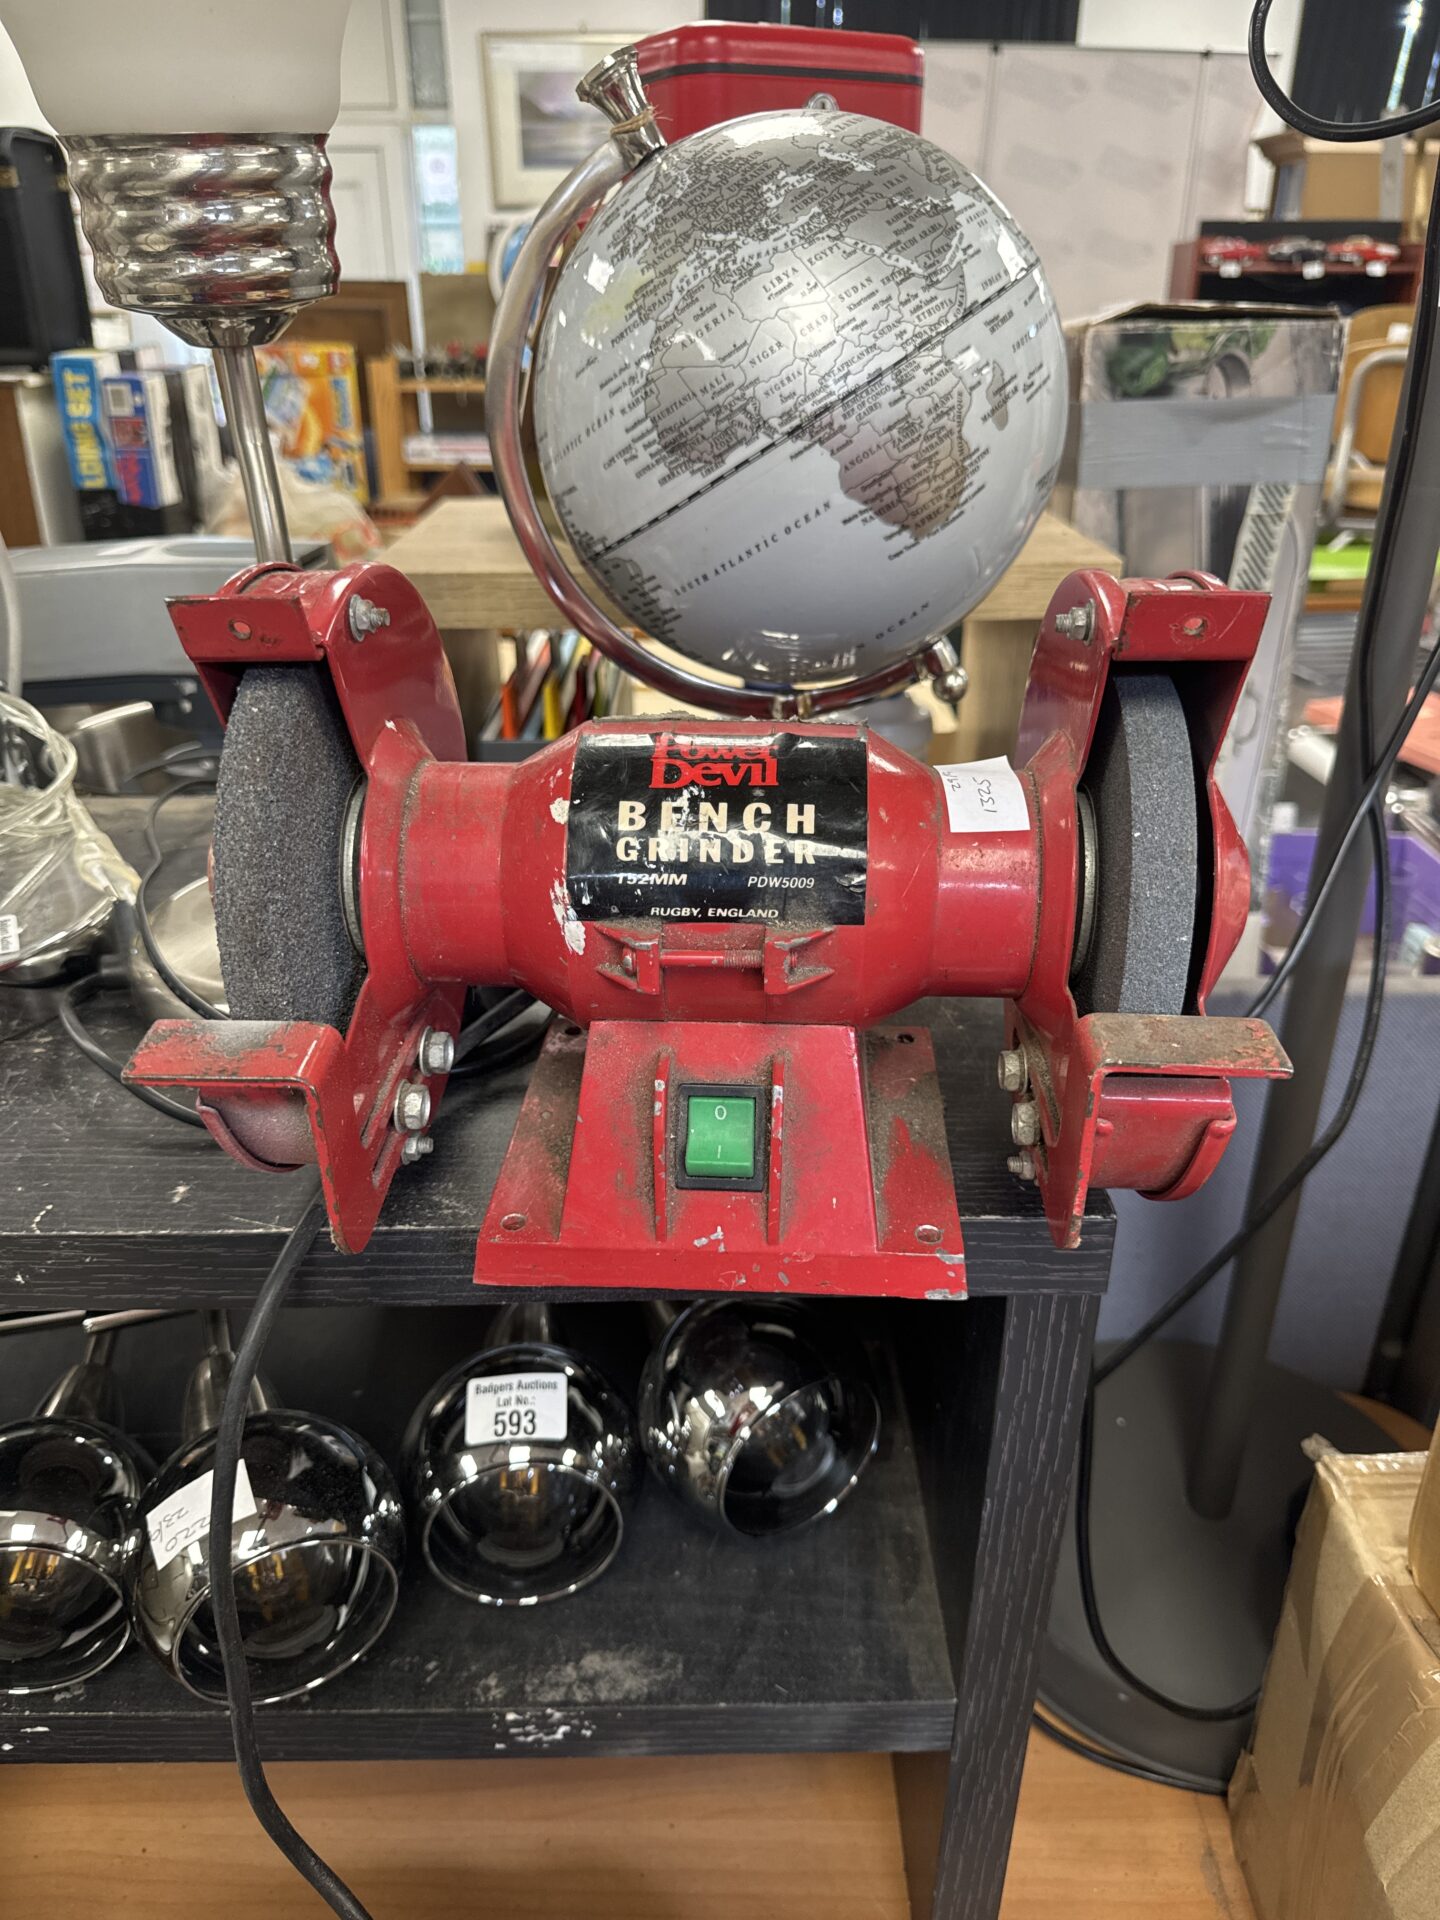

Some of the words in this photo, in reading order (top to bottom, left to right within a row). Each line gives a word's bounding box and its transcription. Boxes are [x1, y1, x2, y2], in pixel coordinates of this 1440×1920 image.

[727, 162, 771, 193] UKRAINE
[884, 173, 908, 190] IRAN
[791, 186, 828, 214] TURKEY
[895, 237, 917, 254] SAUDI
[918, 221, 943, 239] ARABIA
[639, 245, 679, 274] FRANCE
[807, 241, 841, 266] EGYPT
[762, 265, 799, 293] LIBYA
[837, 276, 873, 302] SUDAN
[646, 291, 673, 313] SPAIN
[915, 298, 954, 324] ETHIOPIA
[679, 307, 735, 350] ALGERIA
[799, 313, 829, 336] CHAD
[748, 340, 784, 368] NIGER
[699, 373, 728, 396] MALI
[762, 369, 802, 398] NIGERIA
[855, 399, 868, 410] OF
[866, 384, 891, 403] CONGO
[841, 442, 882, 473] ANGOLA
[912, 501, 951, 530] AFRICA
[713, 533, 779, 577] ATLANTIC
[784, 500, 832, 536] OCEAN
[649, 759, 779, 789] Devil
[972, 777, 998, 813] 1325
[617, 800, 816, 834] BENCH
[615, 836, 817, 865] GRINDER
[747, 875, 815, 889] PDW5009
[650, 906, 702, 918] RUGBY,
[707, 907, 779, 919] ENGLAND
[475, 1382, 515, 1395] Badgers
[517, 1379, 558, 1391] Auctions
[496, 1396, 512, 1407] Lot
[494, 1409, 536, 1437] 593
